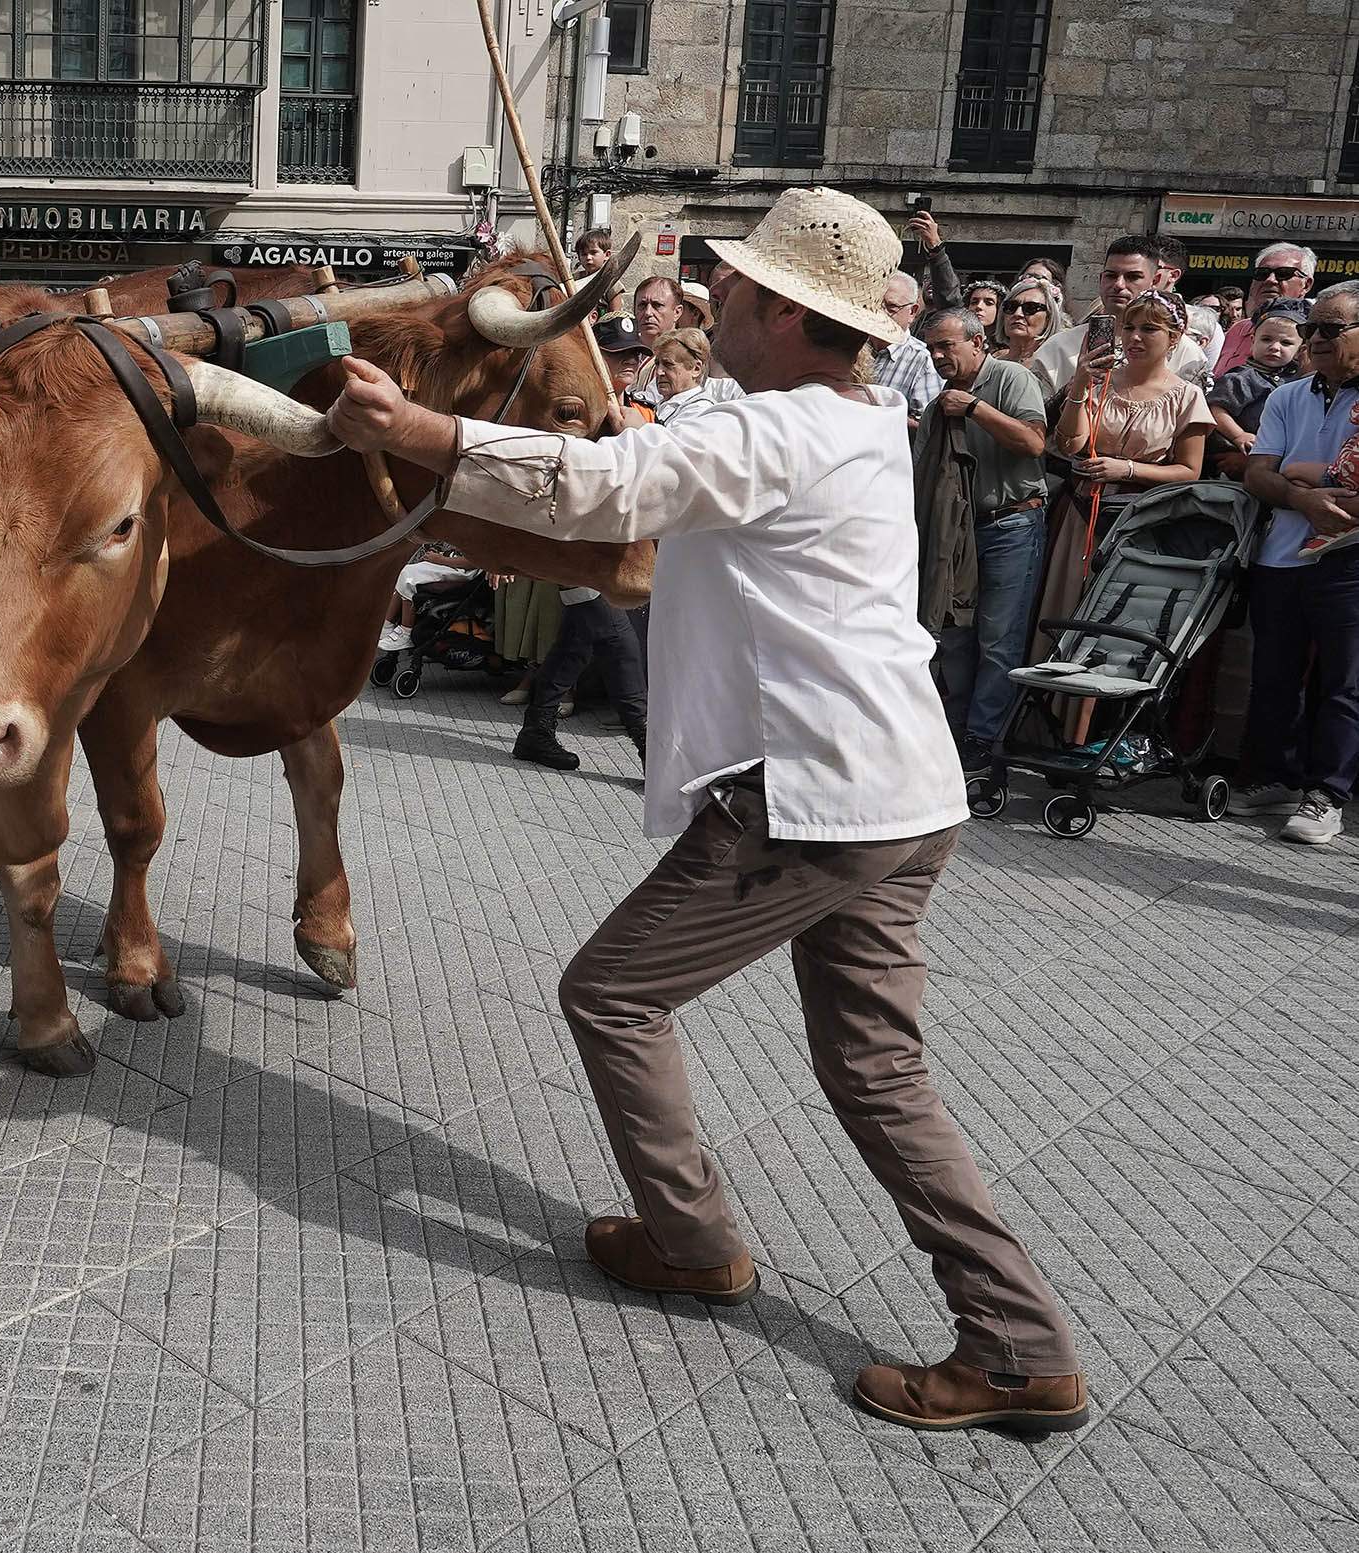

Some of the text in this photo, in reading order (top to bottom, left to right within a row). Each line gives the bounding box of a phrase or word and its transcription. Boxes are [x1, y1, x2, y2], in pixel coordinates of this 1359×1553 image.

[1232, 210, 1359, 232] CROQUETERÍ
[1, 241, 130, 263] PEDROSA
[248, 246, 373, 266] AGASALLO
[426, 249, 454, 260] galega
[1188, 256, 1249, 270] UETONES
